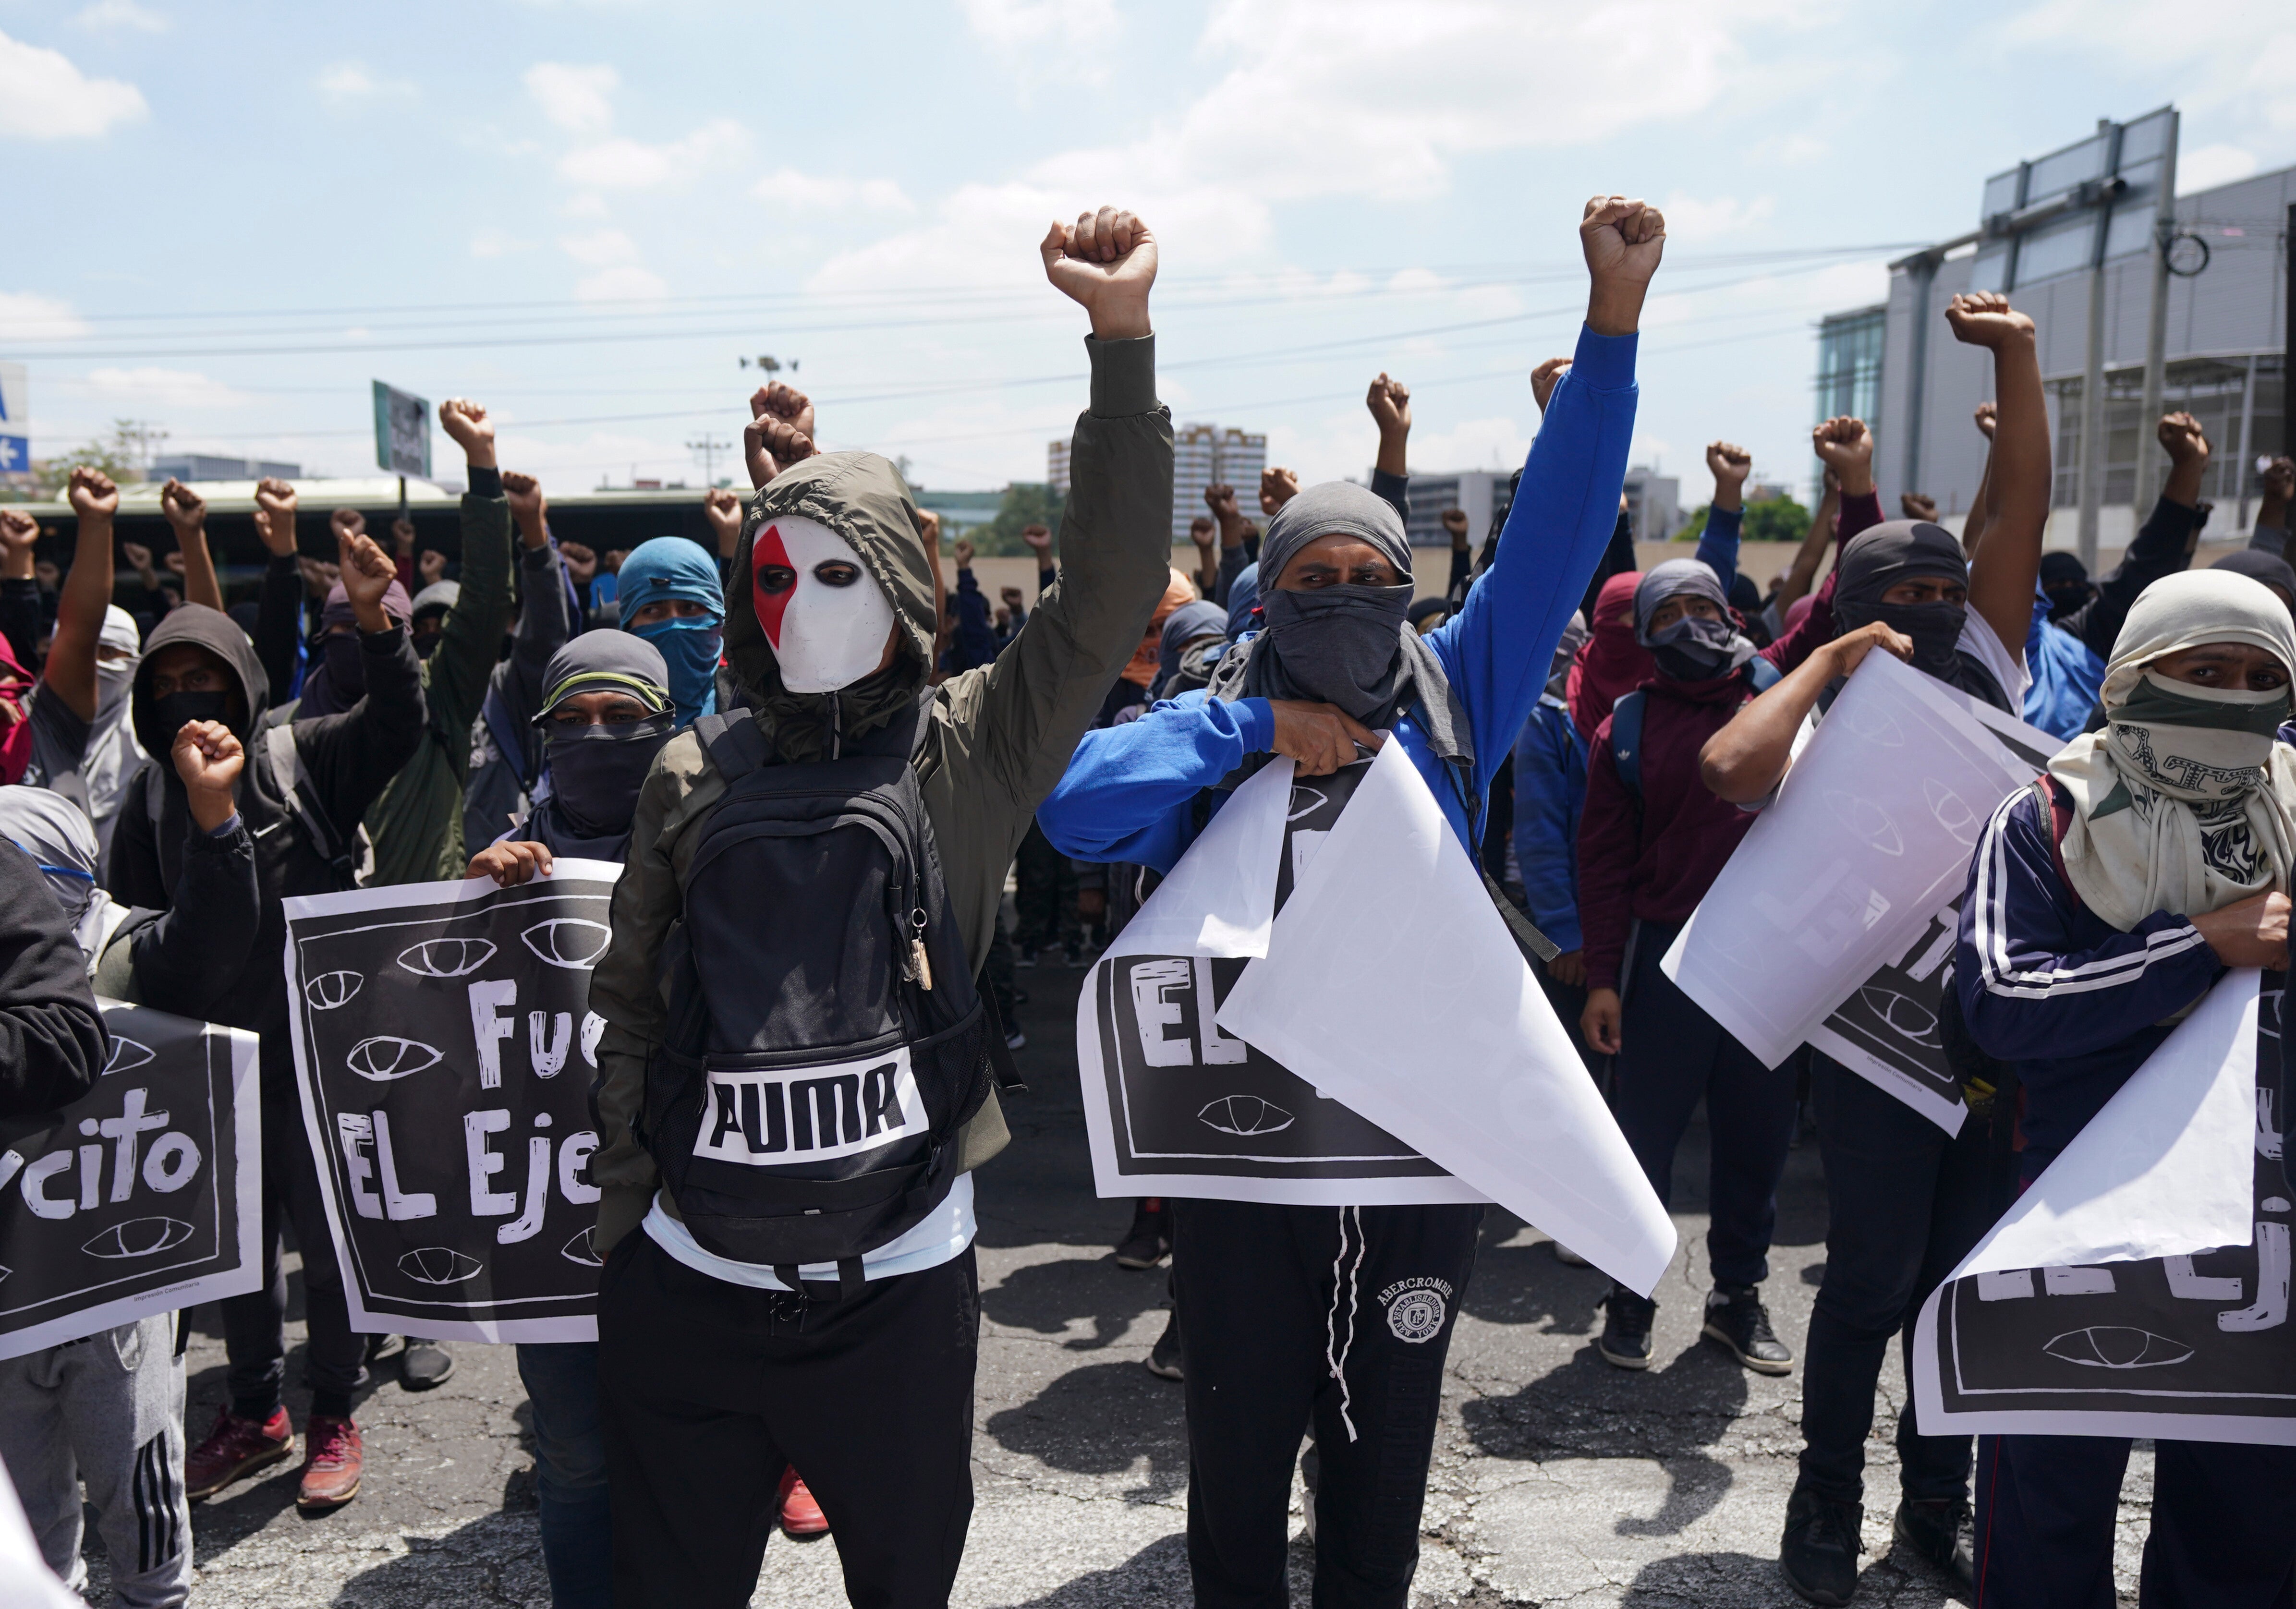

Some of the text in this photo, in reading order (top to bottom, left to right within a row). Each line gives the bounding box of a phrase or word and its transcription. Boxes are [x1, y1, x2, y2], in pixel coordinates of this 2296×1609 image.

[1130, 957, 1248, 1068] EL
[709, 1062, 906, 1153] PUMA
[337, 1110, 437, 1221] EL
[134, 1281, 200, 1302] Impresión Comunitaria
[1377, 1276, 1453, 1307] ABERCROMBIE
[1393, 1294, 1437, 1321] ESTABLISHED
[1395, 1319, 1438, 1338] NEW YORK
